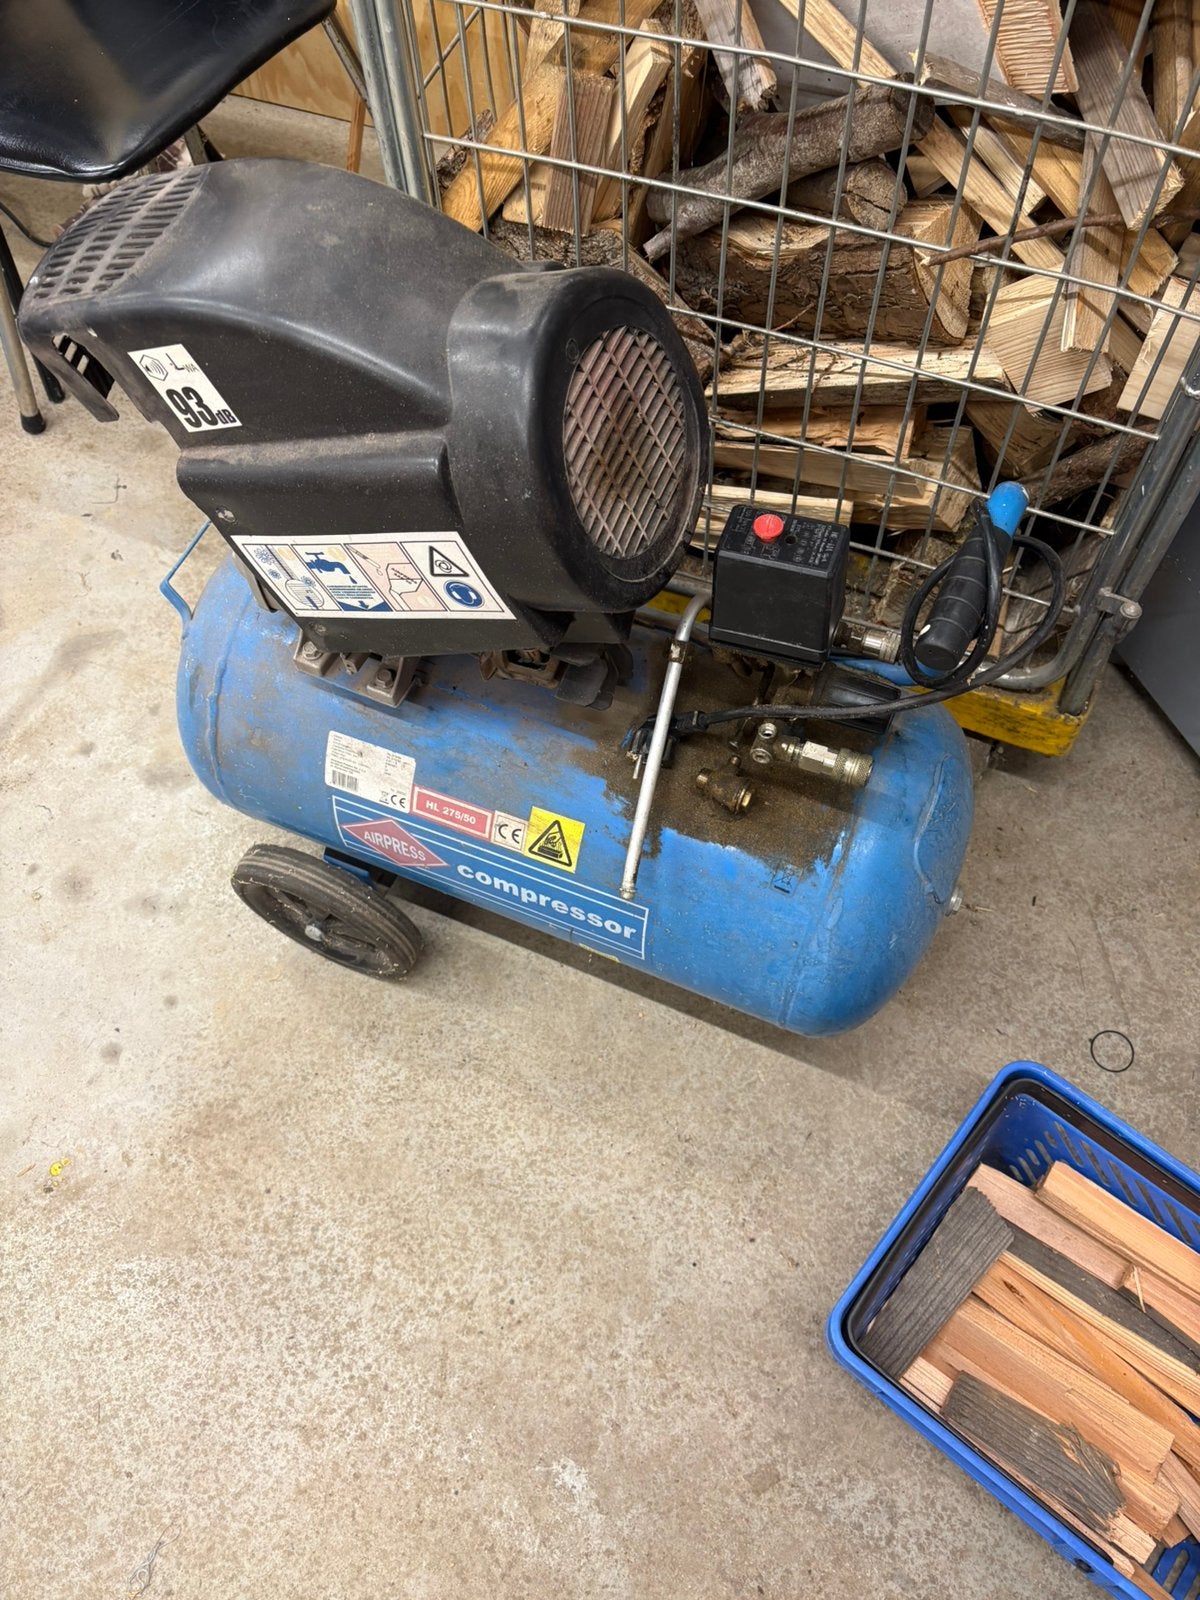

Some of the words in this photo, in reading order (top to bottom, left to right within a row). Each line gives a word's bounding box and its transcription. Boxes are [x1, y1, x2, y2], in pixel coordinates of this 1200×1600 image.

[390, 794, 406, 809] CE
[425, 800, 440, 812] HL
[442, 806, 477, 825] 275/50
[364, 831, 427, 861] AIRPRESS
[498, 823, 522, 844] CE
[457, 864, 637, 939] compressor
